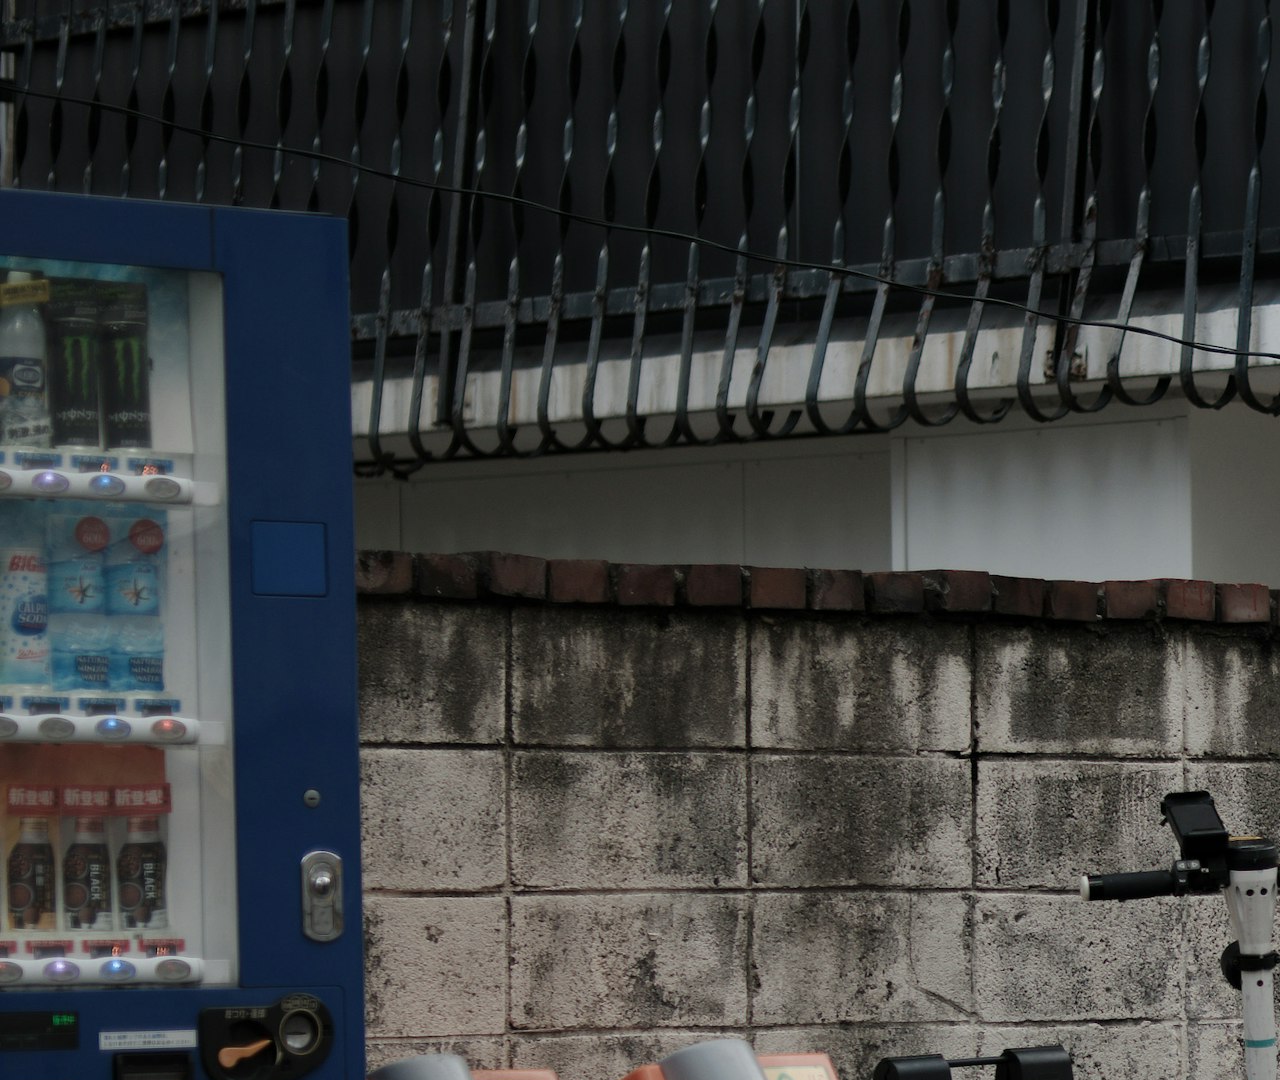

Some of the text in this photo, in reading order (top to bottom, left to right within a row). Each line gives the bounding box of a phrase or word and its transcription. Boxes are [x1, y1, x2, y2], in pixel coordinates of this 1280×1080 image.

[8, 556, 38, 572] BIG
[90, 864, 102, 901] BLACK
[143, 863, 156, 900] BLACK
